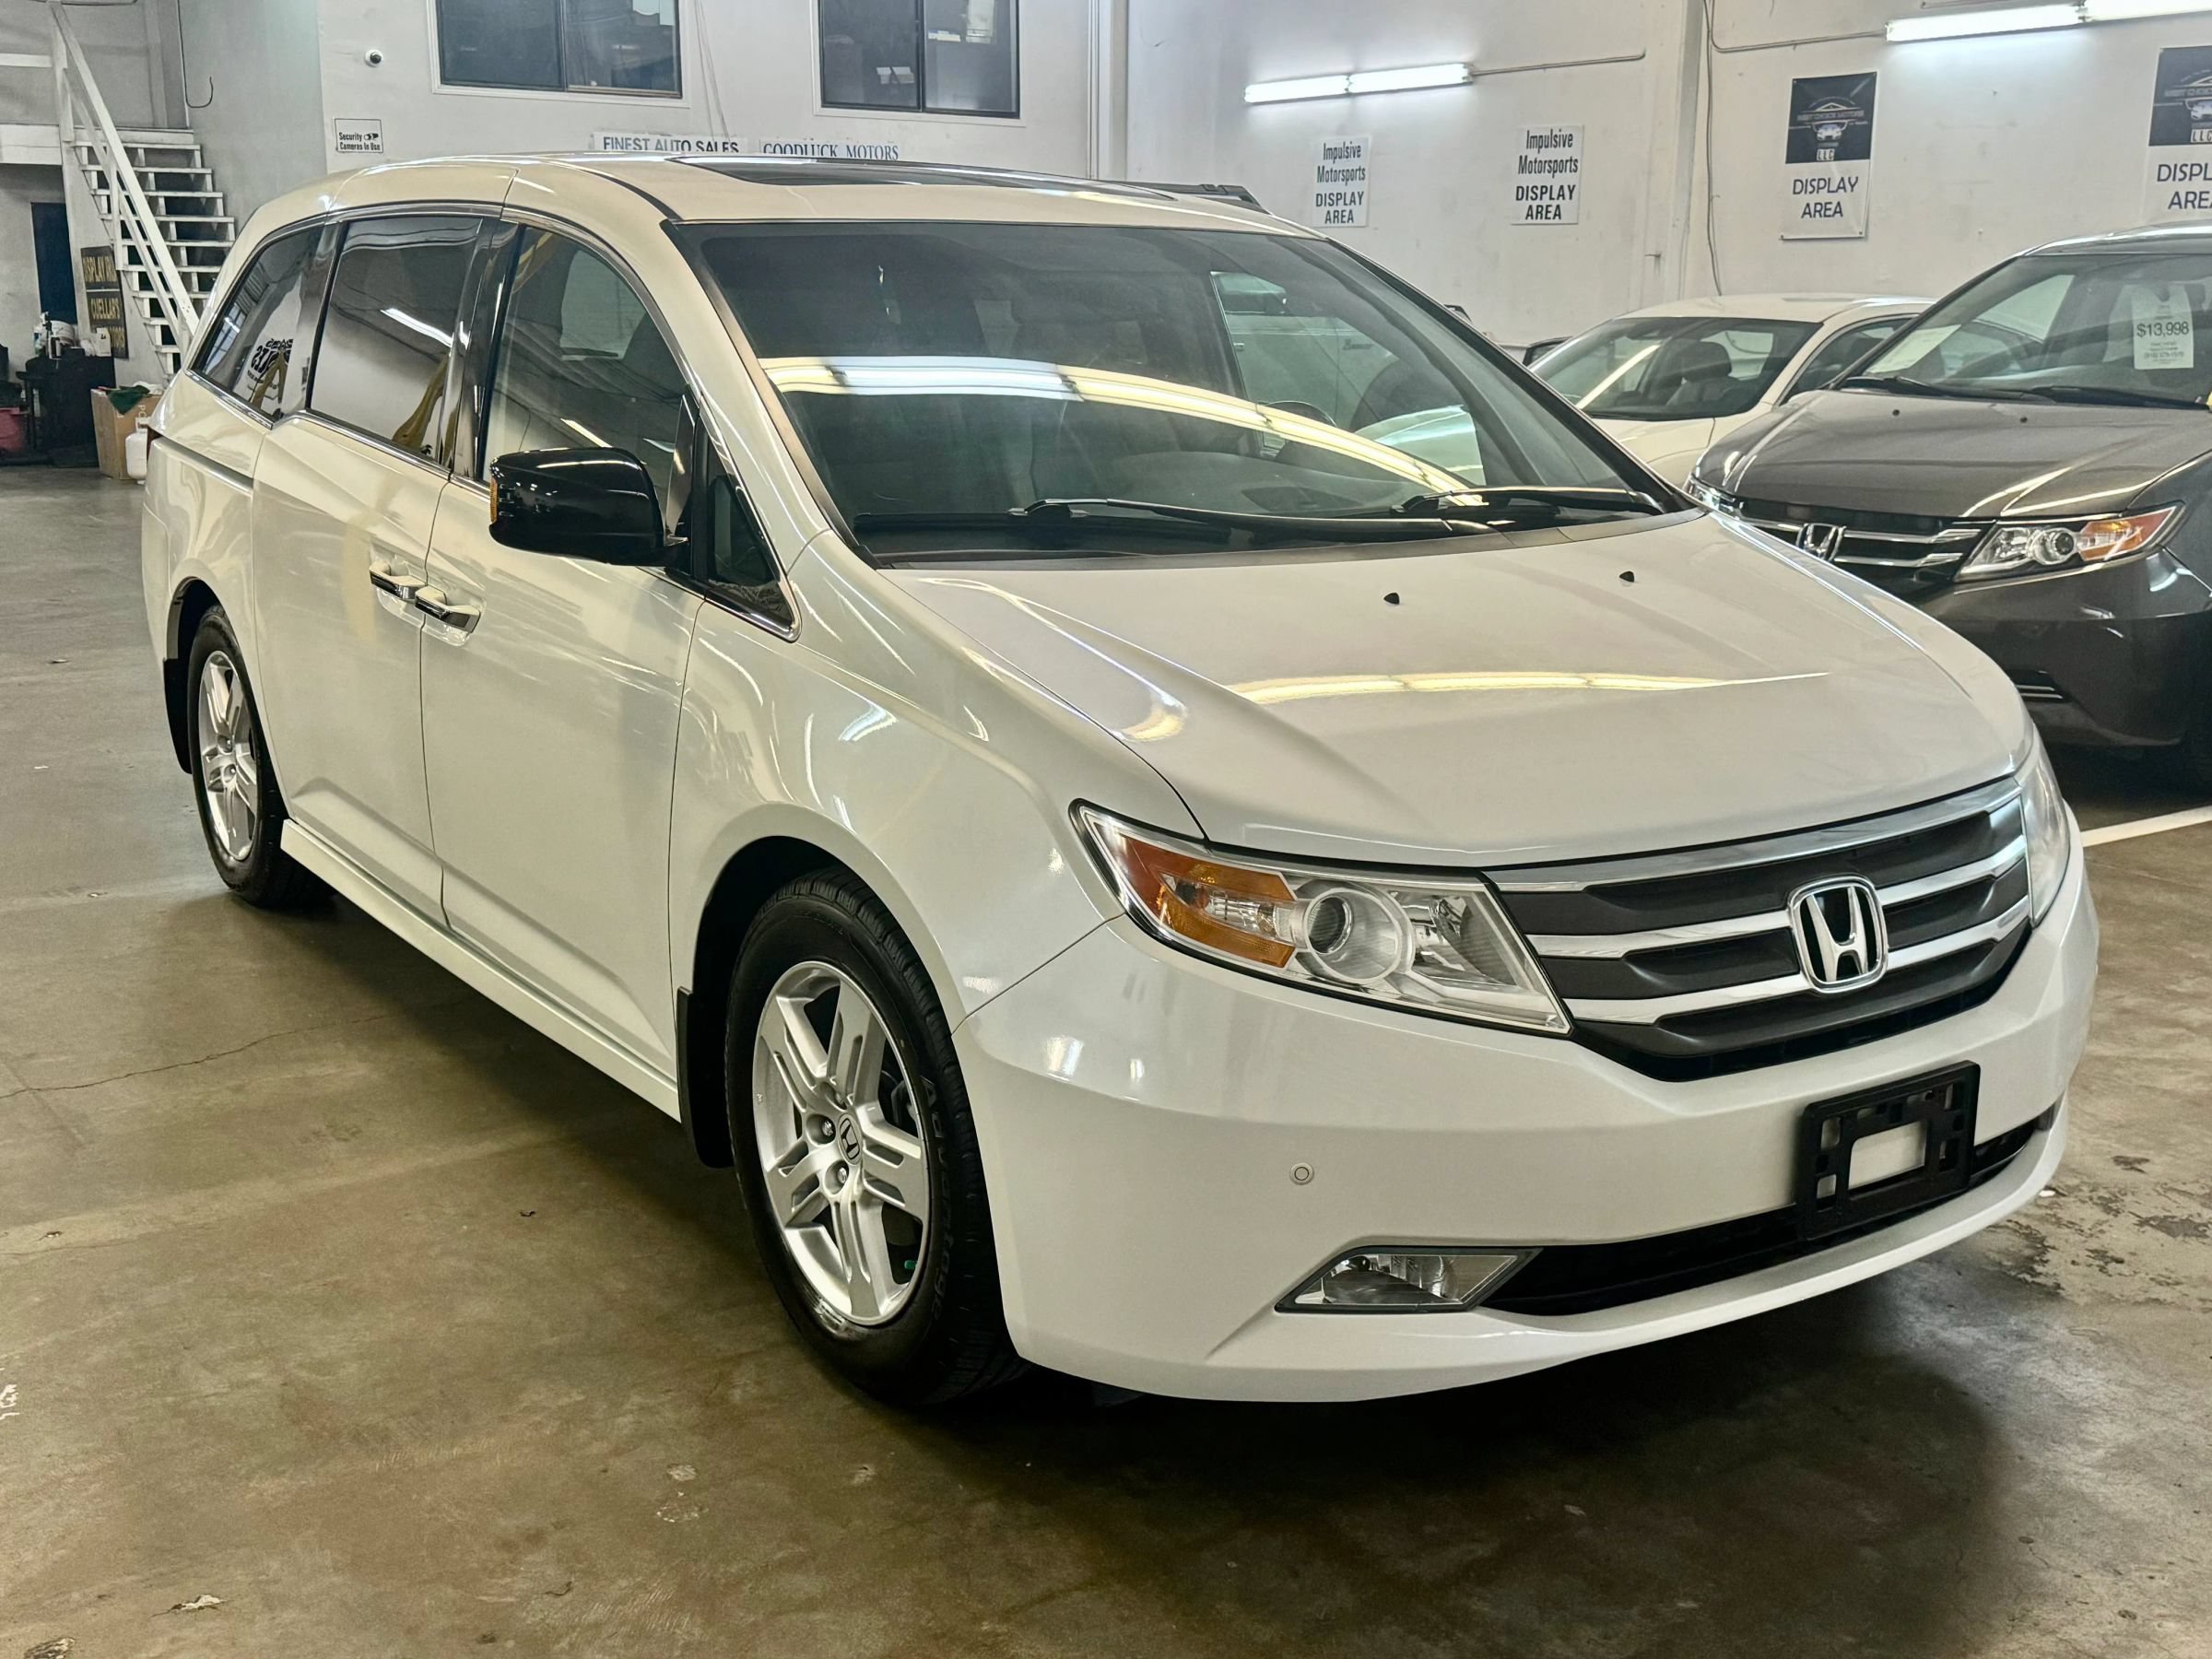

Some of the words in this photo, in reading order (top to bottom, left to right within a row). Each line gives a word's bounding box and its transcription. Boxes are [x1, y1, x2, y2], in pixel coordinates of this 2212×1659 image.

[339, 132, 362, 142] Security
[603, 136, 650, 151] FINEST
[655, 138, 691, 152] AUTO
[696, 140, 739, 153] SALES
[1526, 128, 1573, 154] Impulsive
[340, 142, 362, 150] Cameras
[763, 143, 839, 158] GOODLUCK
[846, 144, 900, 160] MOTORS
[1324, 141, 1361, 164] Impulsive
[1317, 165, 1366, 186] Motorsports
[1518, 155, 1579, 179] Motorsports
[1515, 184, 1576, 201] DISPLAY
[1793, 176, 1859, 195] DISPLAY
[1315, 191, 1364, 207] DISPLAY
[2168, 191, 2212, 210] ARE
[1324, 209, 1354, 224] AREA
[1525, 204, 1561, 220] AREA
[1801, 201, 1843, 218] AREA
[2136, 321, 2190, 338] $13,998
